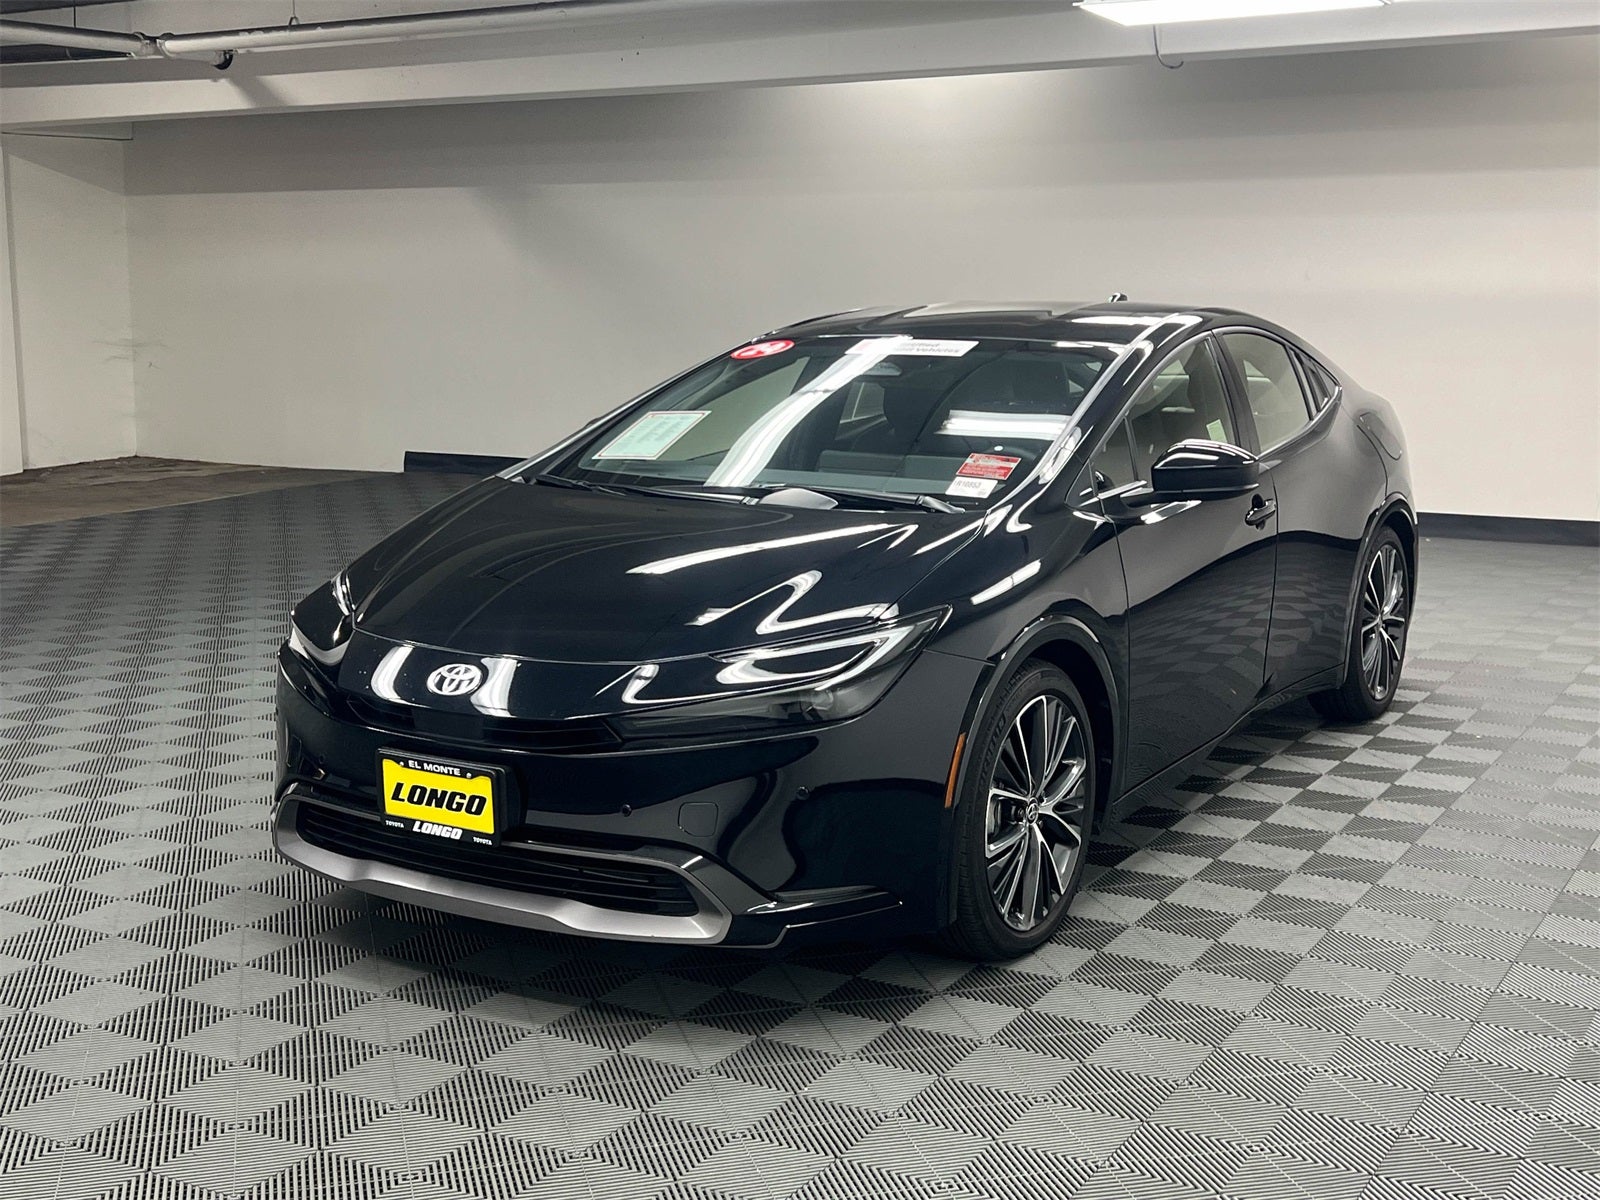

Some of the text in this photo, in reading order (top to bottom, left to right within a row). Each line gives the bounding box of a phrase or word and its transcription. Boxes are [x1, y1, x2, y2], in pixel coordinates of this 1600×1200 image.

[408, 760, 461, 776] EL MONTE
[391, 782, 487, 816] LONGO
[385, 820, 493, 846] TOYOTA LONGO TOYOTA
